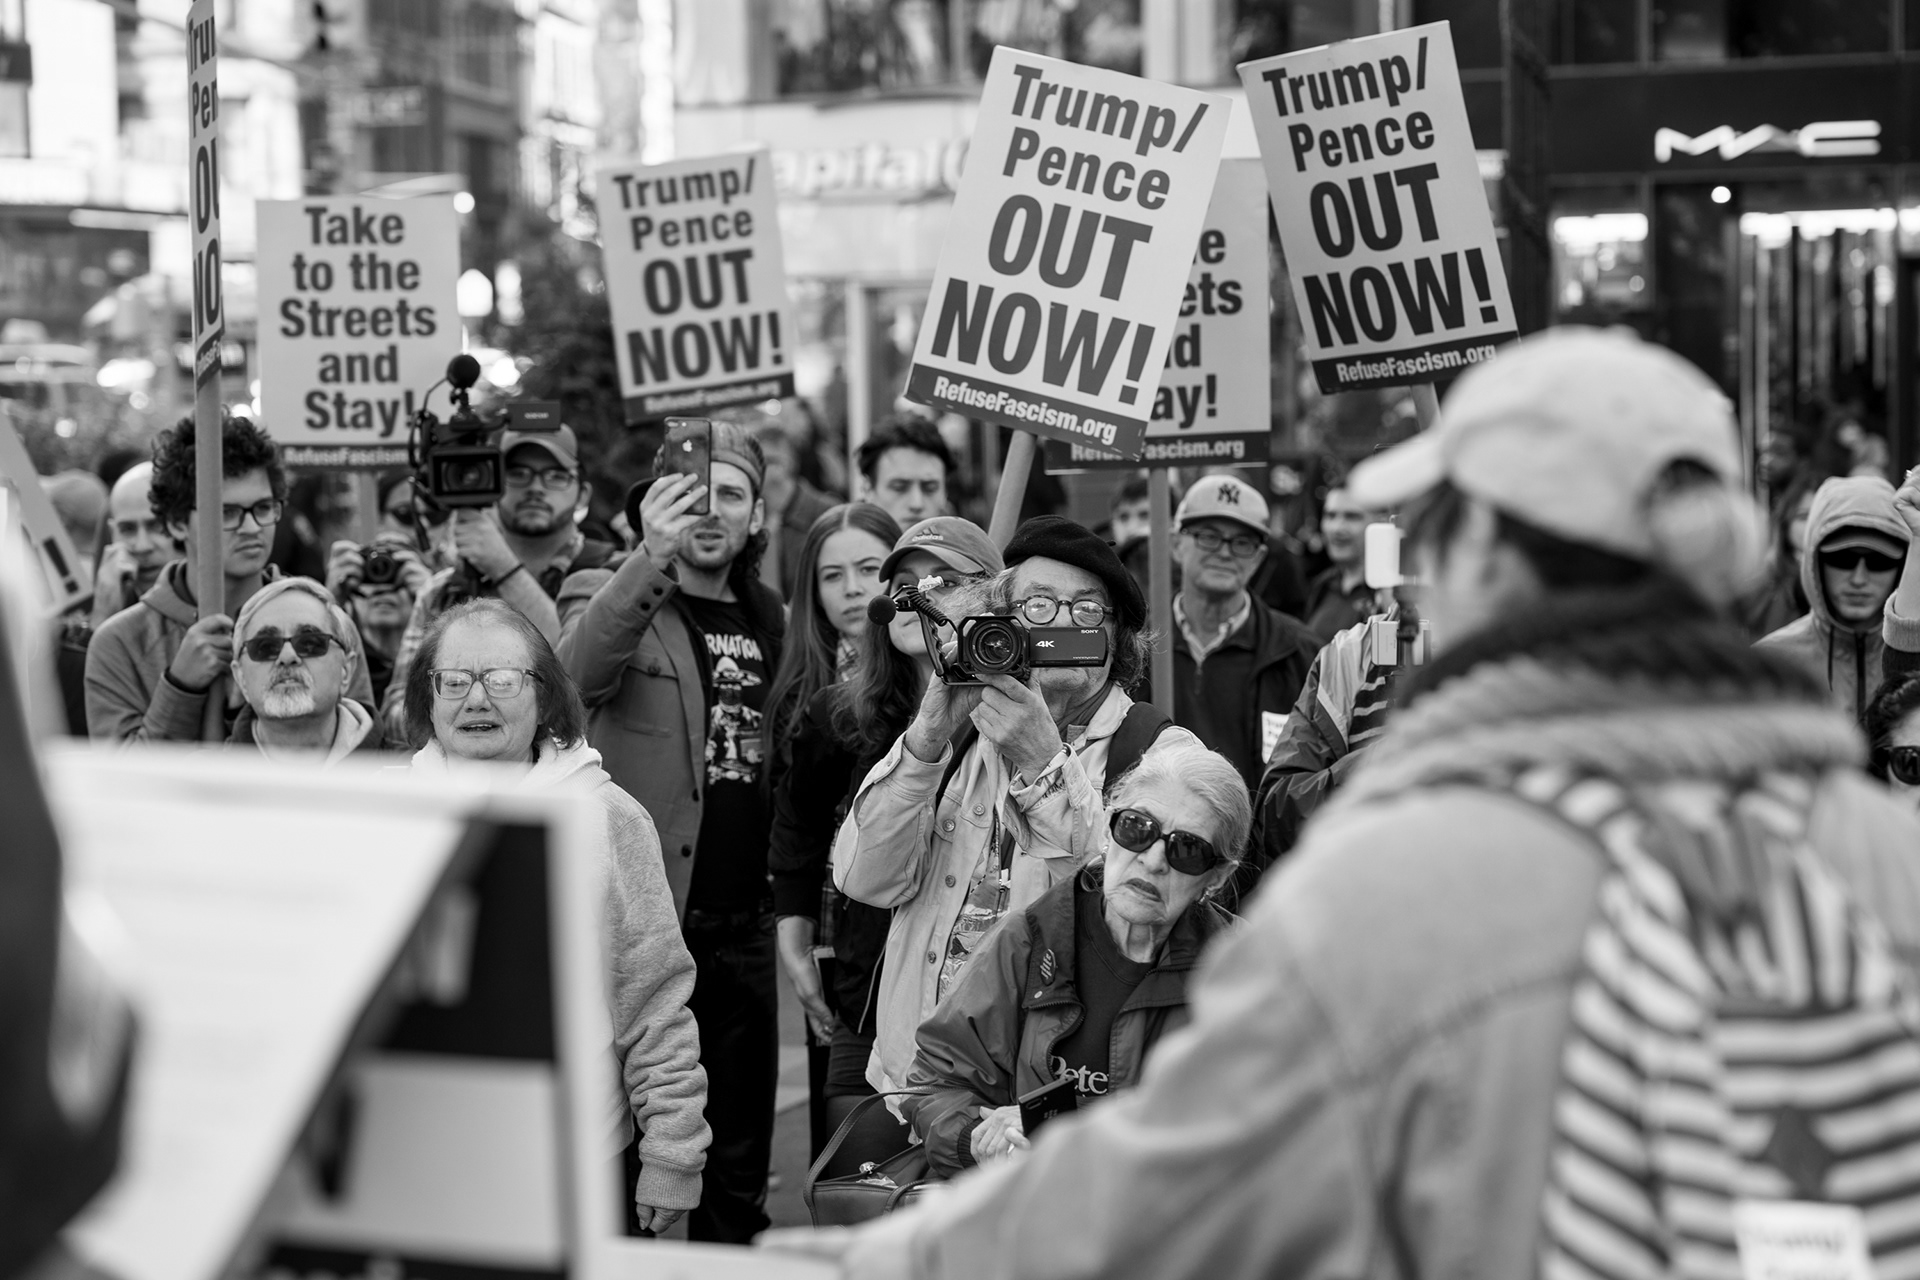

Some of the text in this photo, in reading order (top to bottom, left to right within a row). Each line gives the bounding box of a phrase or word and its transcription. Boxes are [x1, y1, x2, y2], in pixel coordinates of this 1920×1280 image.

[1261, 36, 1428, 118] Trump/
[1011, 63, 1209, 157] Trump/
[1287, 111, 1435, 173] Pence
[612, 158, 755, 210] Trump/
[1003, 126, 1170, 210] Pence
[304, 206, 404, 245] Take
[630, 210, 753, 251] Pence
[1309, 161, 1440, 259] OUT
[292, 252, 420, 292] to the
[988, 194, 1154, 302] OUT
[643, 248, 753, 316] OUT
[1301, 247, 1499, 350] NOW!
[280, 298, 437, 338] Streets
[626, 311, 783, 387] NOW!
[930, 277, 1156, 406] NOW!
[318, 344, 399, 384] and
[1336, 344, 1497, 383] RefuseFascism.org
[304, 389, 414, 438] Stay!
[933, 376, 1117, 446] RefuseFascism.org
[1035, 640, 1055, 648] 4K
